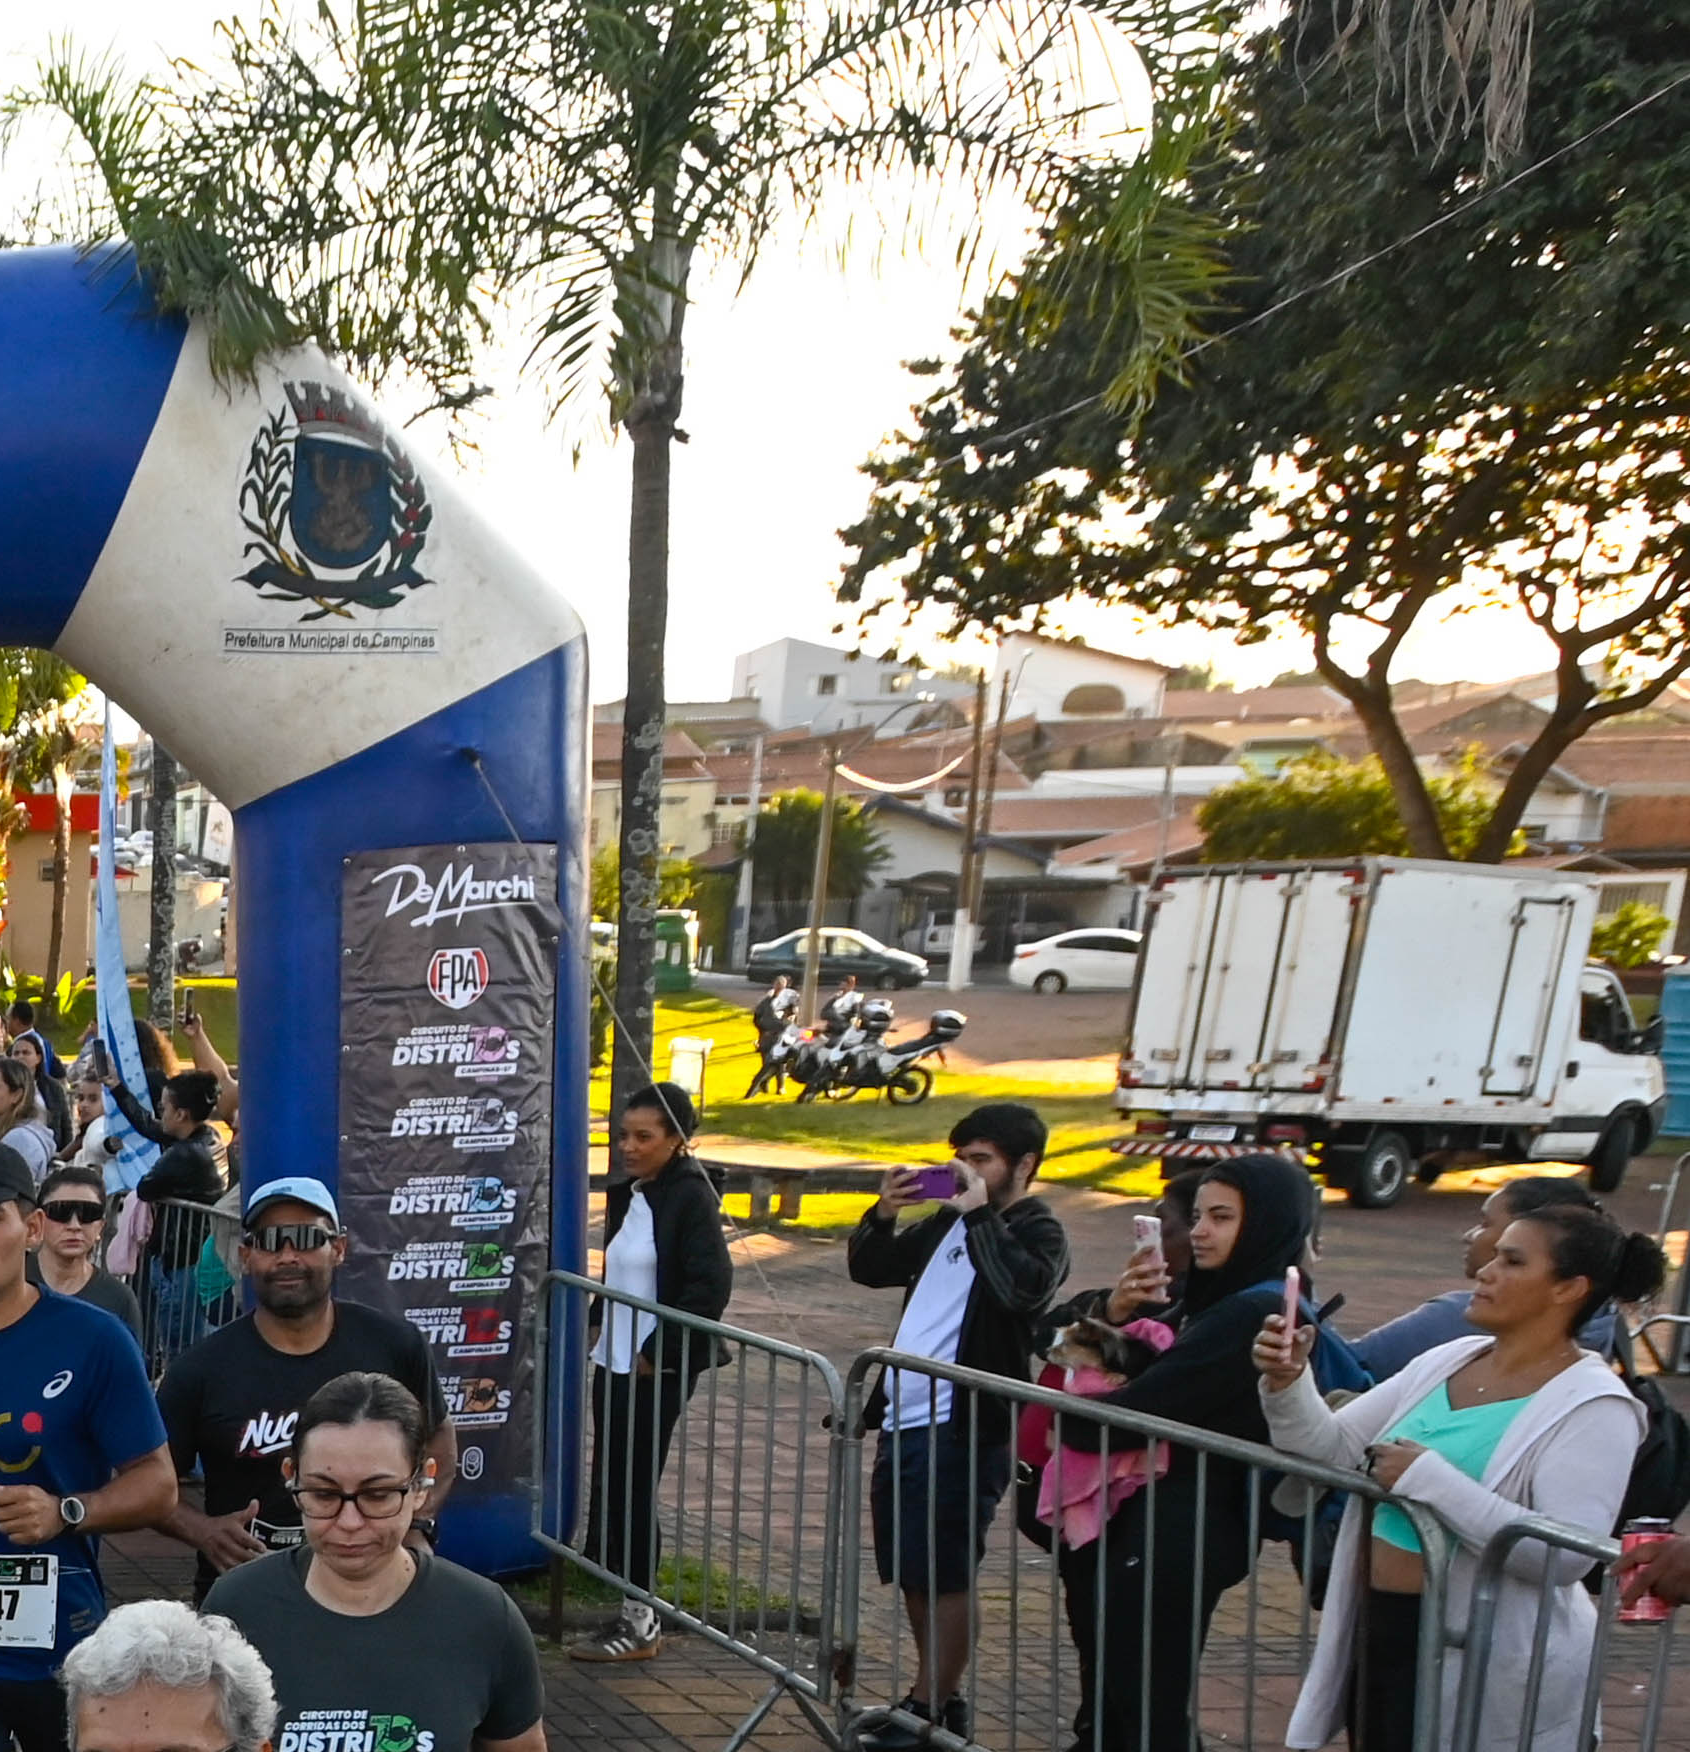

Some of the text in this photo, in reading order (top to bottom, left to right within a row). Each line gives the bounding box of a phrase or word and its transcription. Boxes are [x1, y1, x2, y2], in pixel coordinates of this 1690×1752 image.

[225, 632, 435, 652] Prefeitura Municipal de Campinas
[438, 954, 479, 999] FPA
[271, 1535, 302, 1544] DISTRI
[300, 1710, 368, 1720] CIRCUITO DE
[284, 1720, 366, 1731] CORRIDAS DOS
